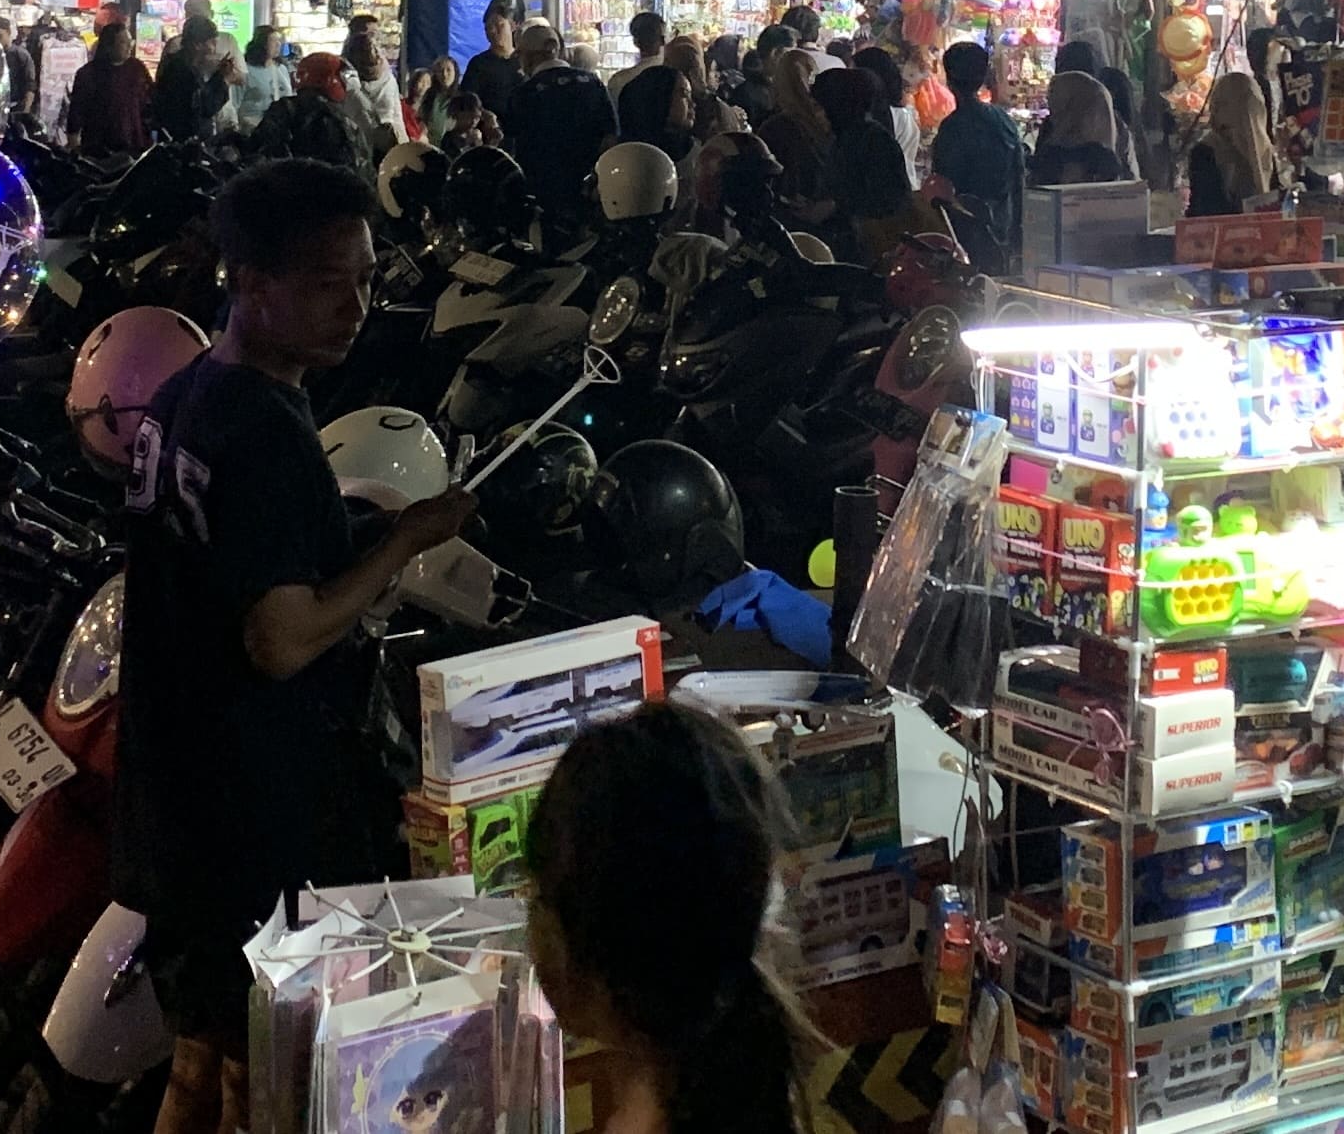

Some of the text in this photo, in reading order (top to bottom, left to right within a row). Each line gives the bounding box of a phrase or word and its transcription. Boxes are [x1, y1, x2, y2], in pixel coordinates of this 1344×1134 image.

[997, 503, 1042, 534] UNO
[1062, 518, 1106, 549] UNO
[1193, 658, 1219, 676] UNO
[1032, 706, 1058, 722] CAR
[1167, 717, 1222, 736] SUPERIOR
[7, 723, 51, 765] 6754
[998, 744, 1059, 774] MODEL CAR
[1165, 771, 1223, 791] SUPERIOR
